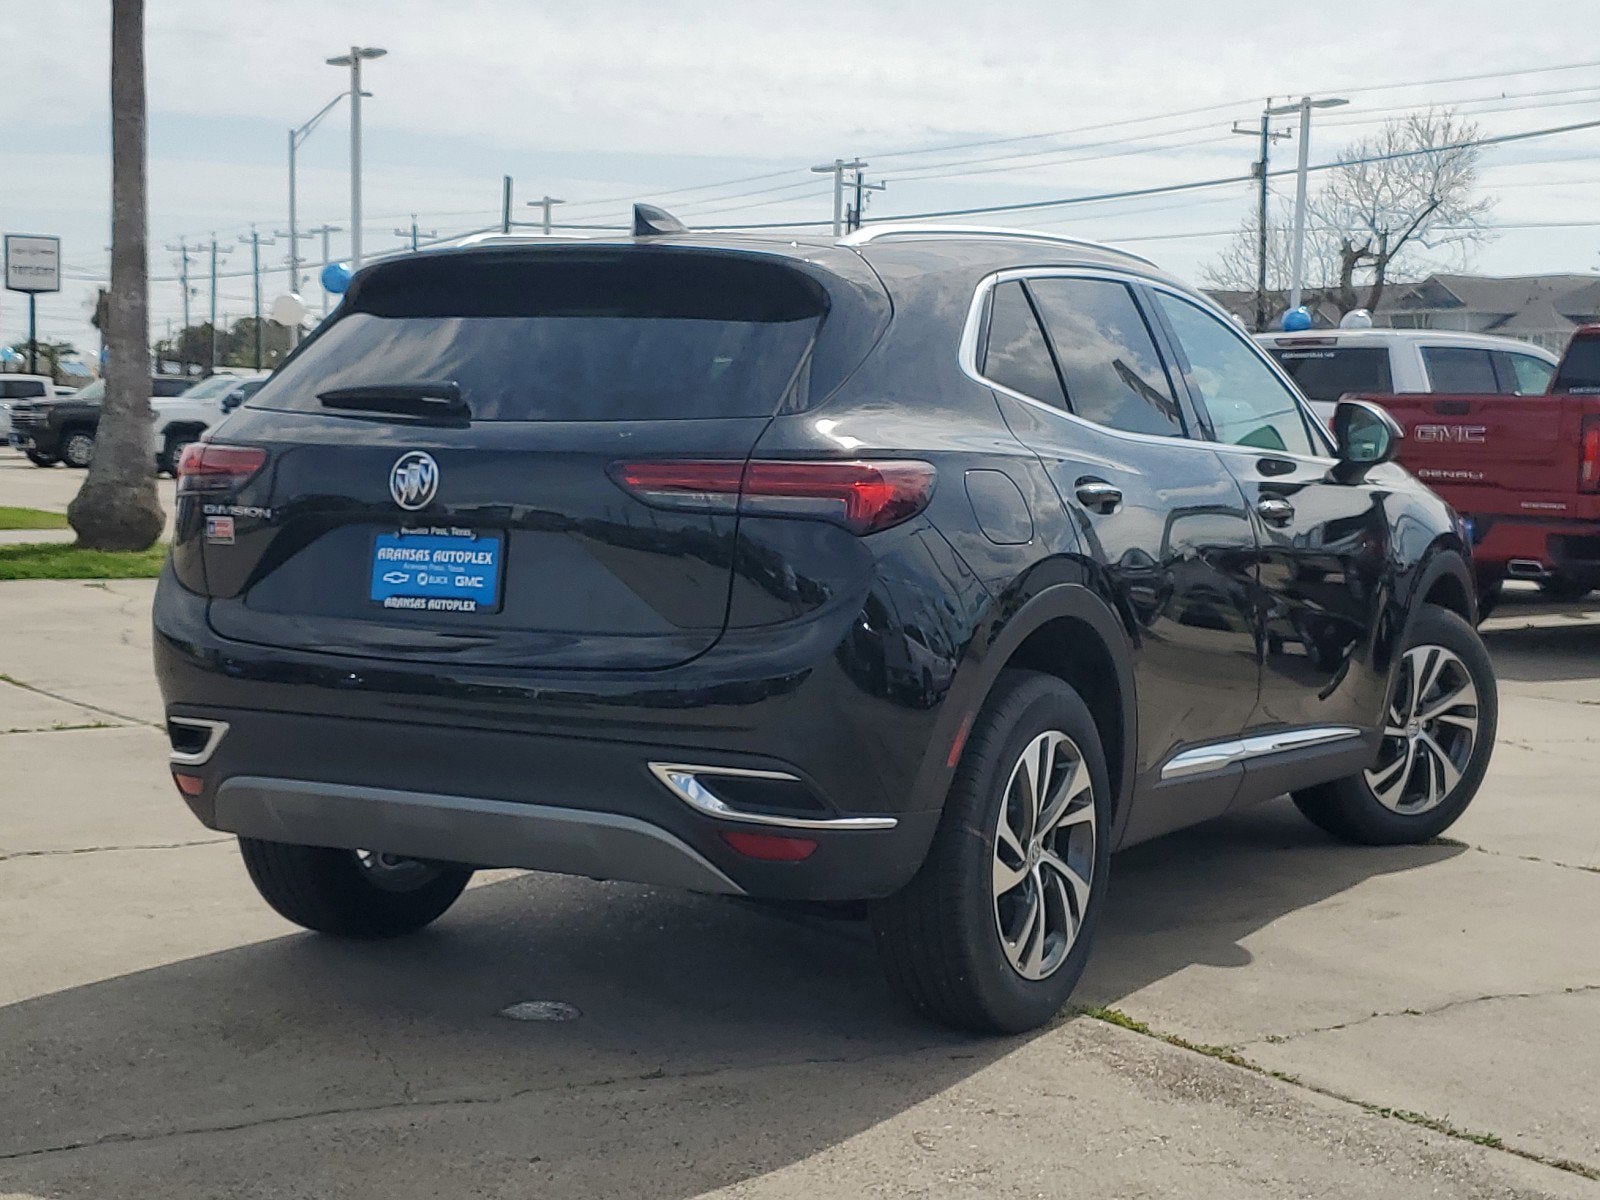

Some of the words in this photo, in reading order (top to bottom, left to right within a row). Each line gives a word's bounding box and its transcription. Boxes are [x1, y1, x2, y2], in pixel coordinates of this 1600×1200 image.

[1414, 424, 1487, 443] GMC
[1418, 468, 1484, 480] DENALI
[377, 548, 430, 561] ARANSAS
[432, 551, 493, 565] AUTOPLEX
[454, 576, 484, 587] GMC
[384, 597, 427, 609] ARANSAS
[427, 599, 476, 612] AUTOPLEX
